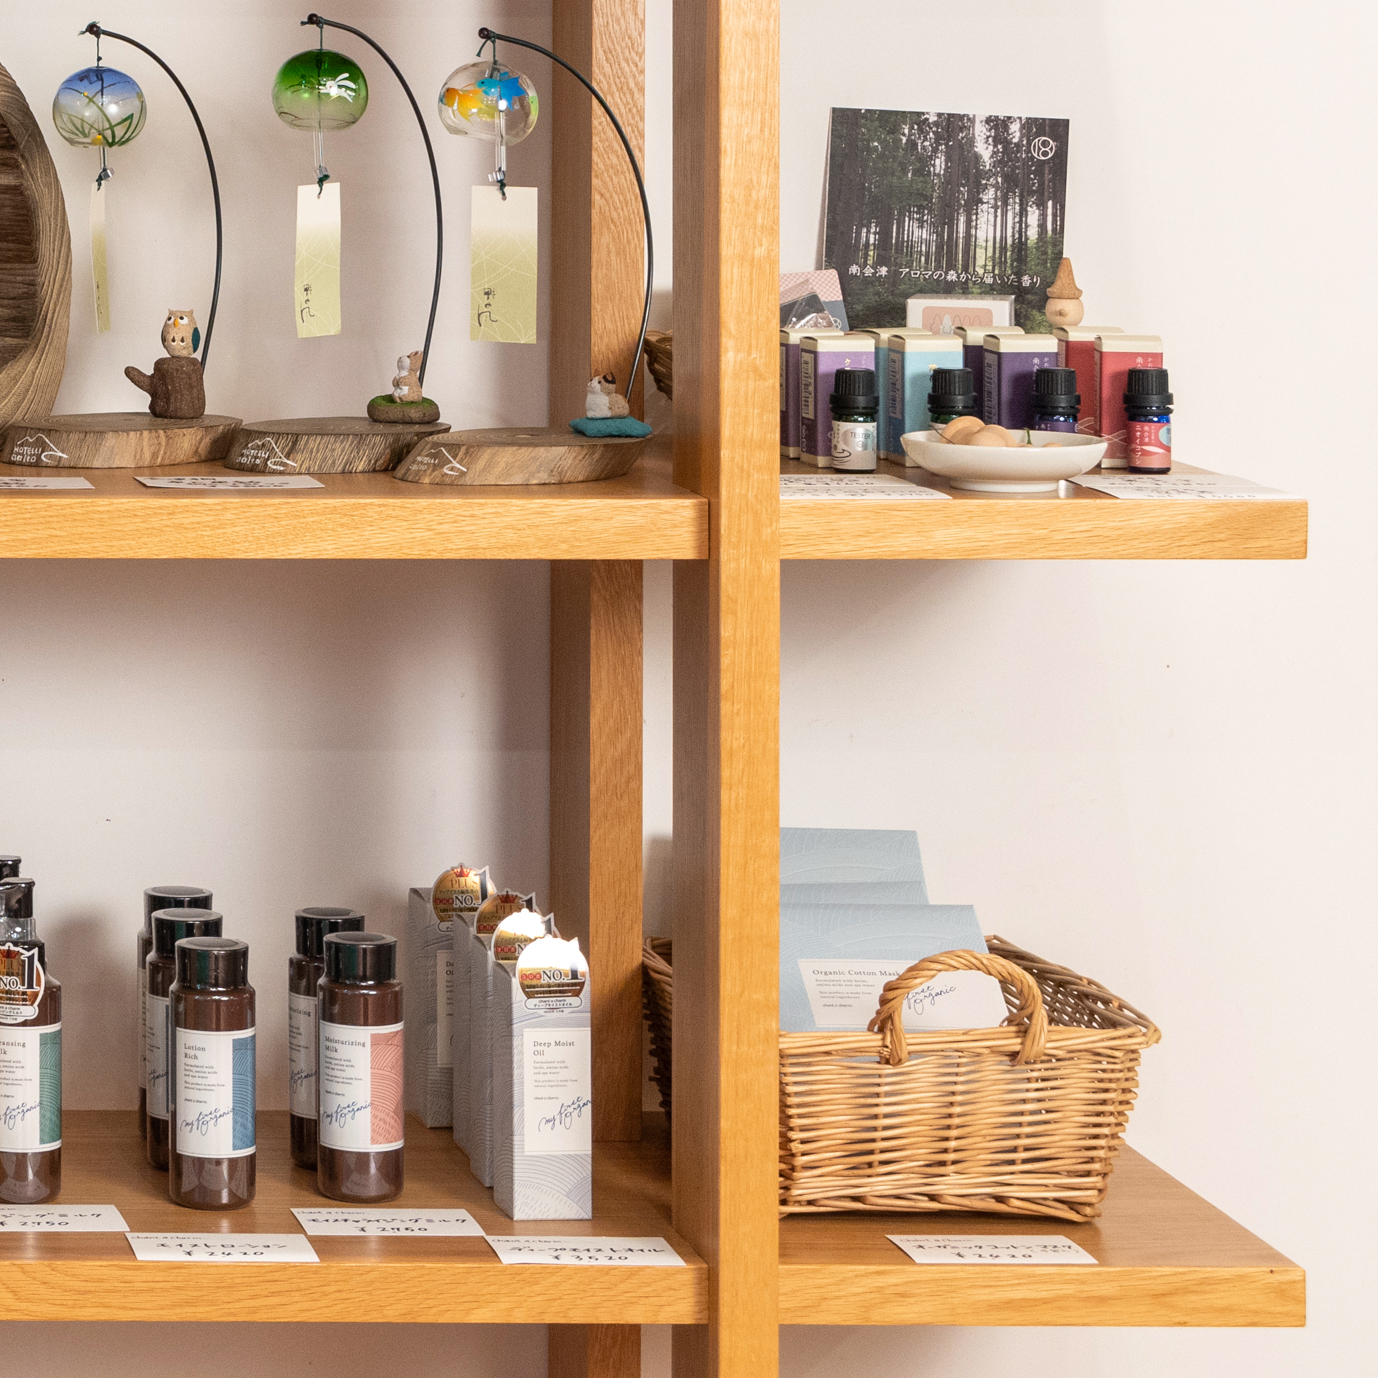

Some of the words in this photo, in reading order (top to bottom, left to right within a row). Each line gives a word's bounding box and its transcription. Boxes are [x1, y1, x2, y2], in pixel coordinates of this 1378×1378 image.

[848, 263, 889, 278] 南会津
[898, 267, 1042, 288] アロマの森から届いた香り
[850, 431, 871, 440] TESTER
[325, 1036, 366, 1048] Moisturizing
[533, 1040, 552, 1048] Deep
[184, 1043, 206, 1052] Lotion
[325, 1045, 339, 1053] Milk
[184, 1052, 199, 1060] Rich
